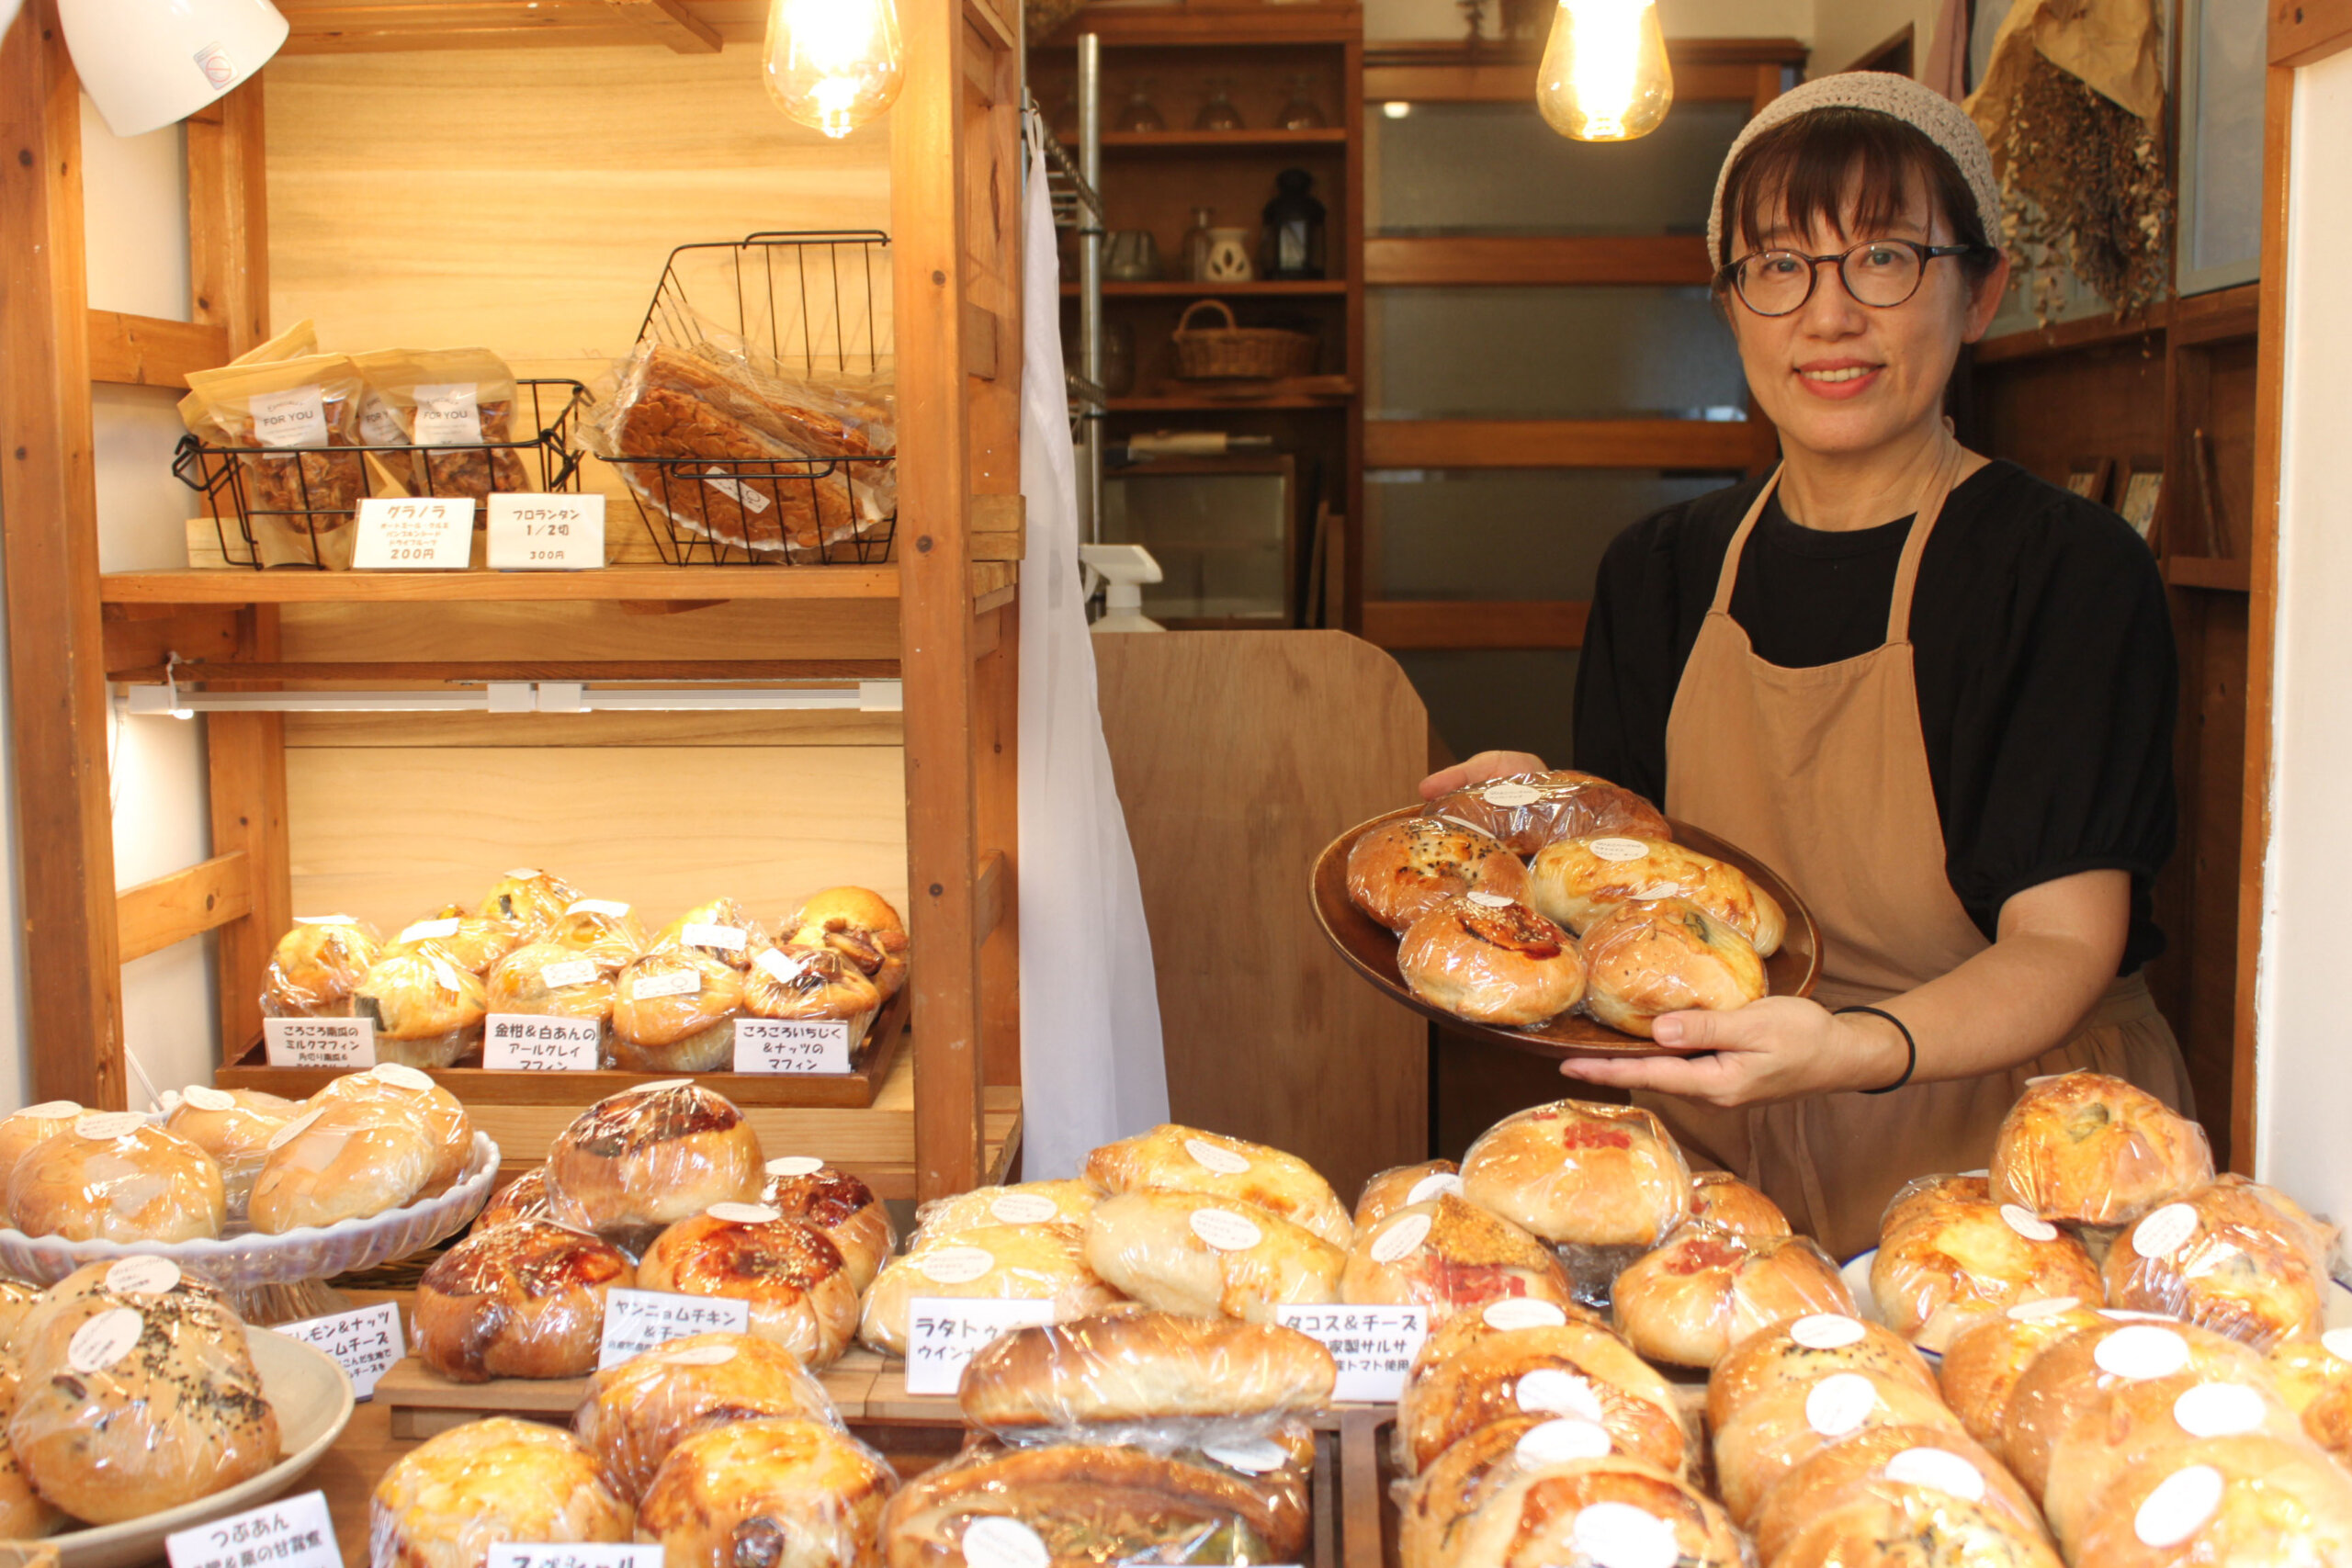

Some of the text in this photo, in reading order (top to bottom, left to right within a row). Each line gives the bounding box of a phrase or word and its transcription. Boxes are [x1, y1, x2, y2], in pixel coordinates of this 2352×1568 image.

[263, 411, 314, 426] FOR YOU
[424, 410, 468, 420] FOR YOU
[387, 505, 447, 519] グラノラ
[513, 509, 580, 521] フロランタン
[390, 548, 435, 559] 200円
[529, 550, 565, 559] 300円
[494, 1022, 596, 1041] 金柑&白あんの
[286, 1040, 360, 1051] ミルクマフィン
[509, 1043, 581, 1057] アールグレイ
[763, 1042, 824, 1055] &ナッツの
[768, 1059, 818, 1070] マフィン
[615, 1300, 736, 1326] ヤンニョムチキン
[1286, 1314, 1418, 1332] タコス&チーズ
[1321, 1338, 1408, 1355] 家製サルサ
[210, 1514, 289, 1549] つぶあん
